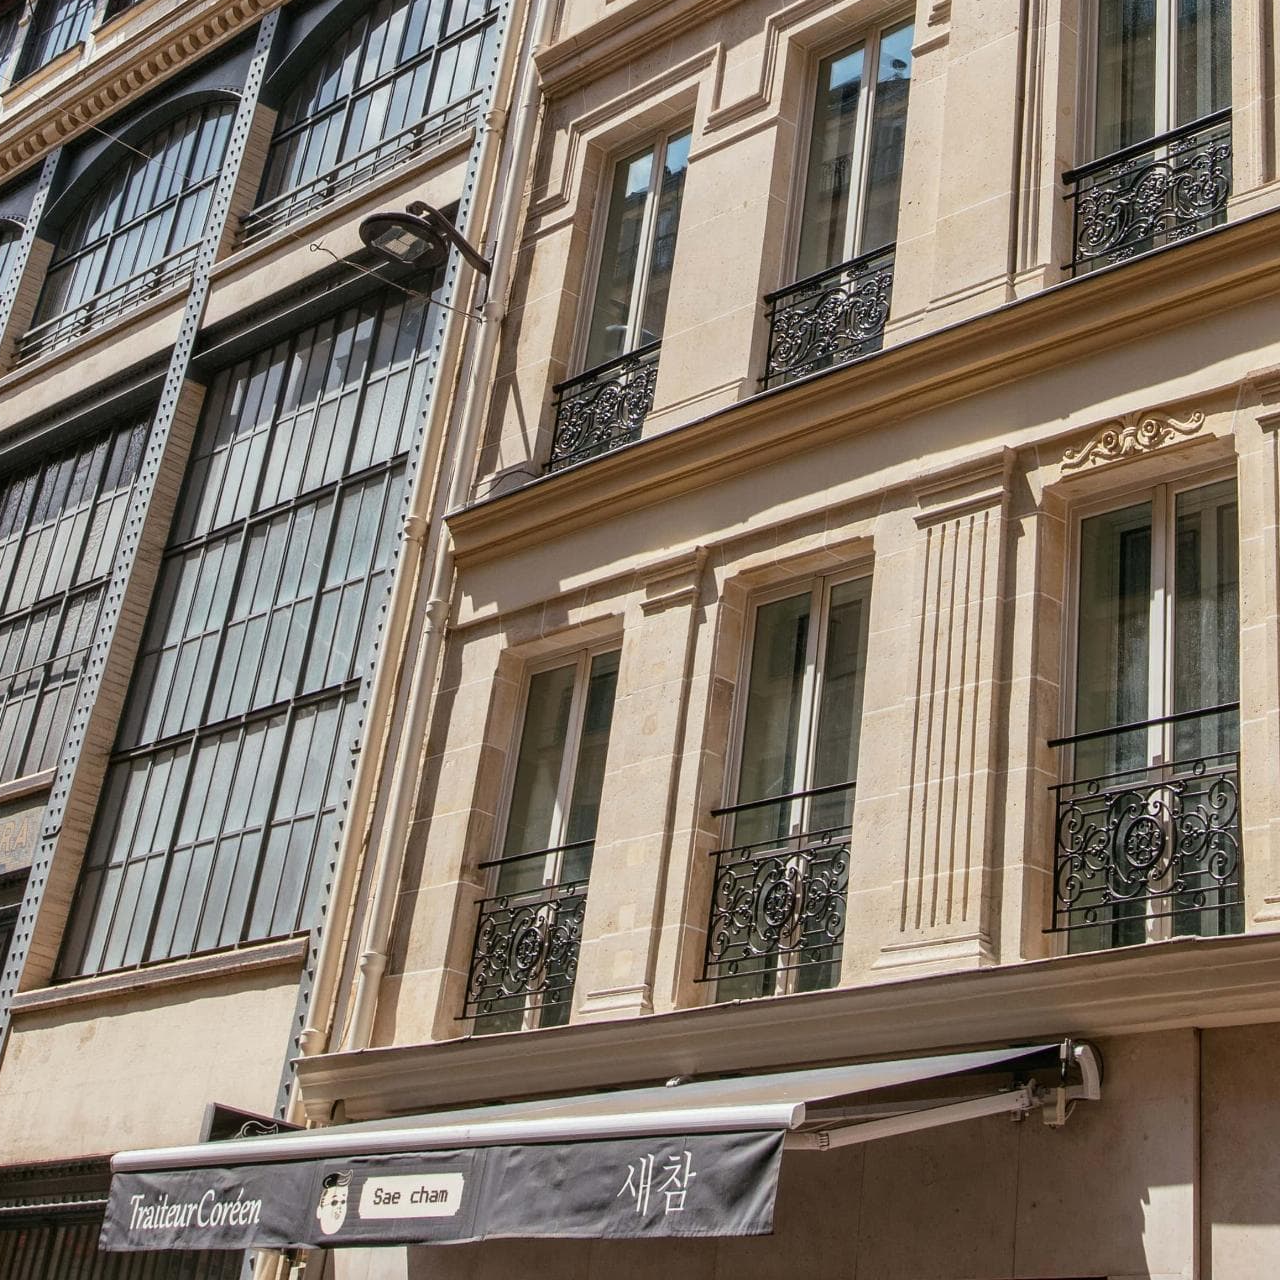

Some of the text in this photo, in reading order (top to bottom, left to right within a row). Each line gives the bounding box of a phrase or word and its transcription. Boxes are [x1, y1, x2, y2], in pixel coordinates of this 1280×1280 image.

[373, 1185, 448, 1206] Sae cham
[617, 1150, 697, 1216] 새참
[130, 1187, 262, 1230] Traiteur Coréen
